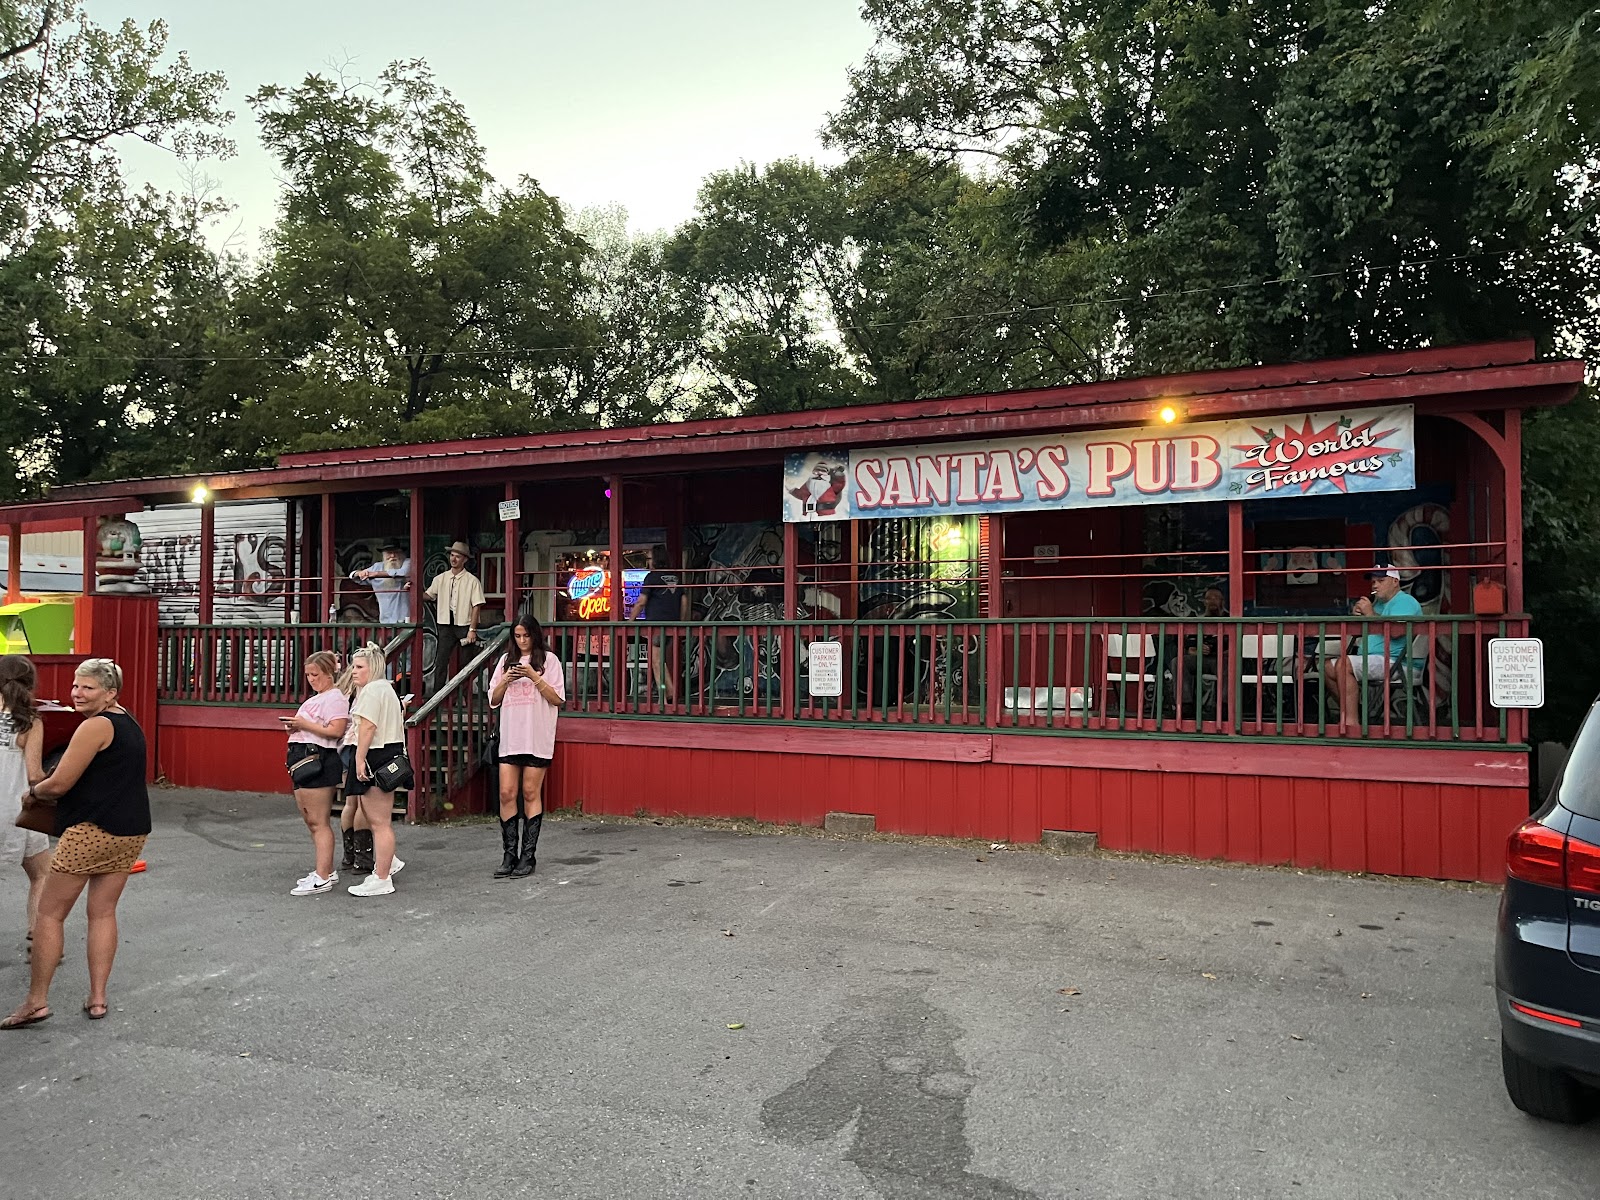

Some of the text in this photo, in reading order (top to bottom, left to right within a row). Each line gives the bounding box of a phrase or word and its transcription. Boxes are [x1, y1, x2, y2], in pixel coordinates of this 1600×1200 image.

[1245, 427, 1376, 467] World
[855, 435, 1222, 509] SANTA'S PUB
[1246, 454, 1384, 491] Famous
[579, 596, 611, 619] Open
[812, 647, 838, 655] CUSTOMER
[1493, 645, 1538, 654] CUSTOMER
[1497, 655, 1534, 663] PARKING
[1504, 663, 1528, 671] ONLY
